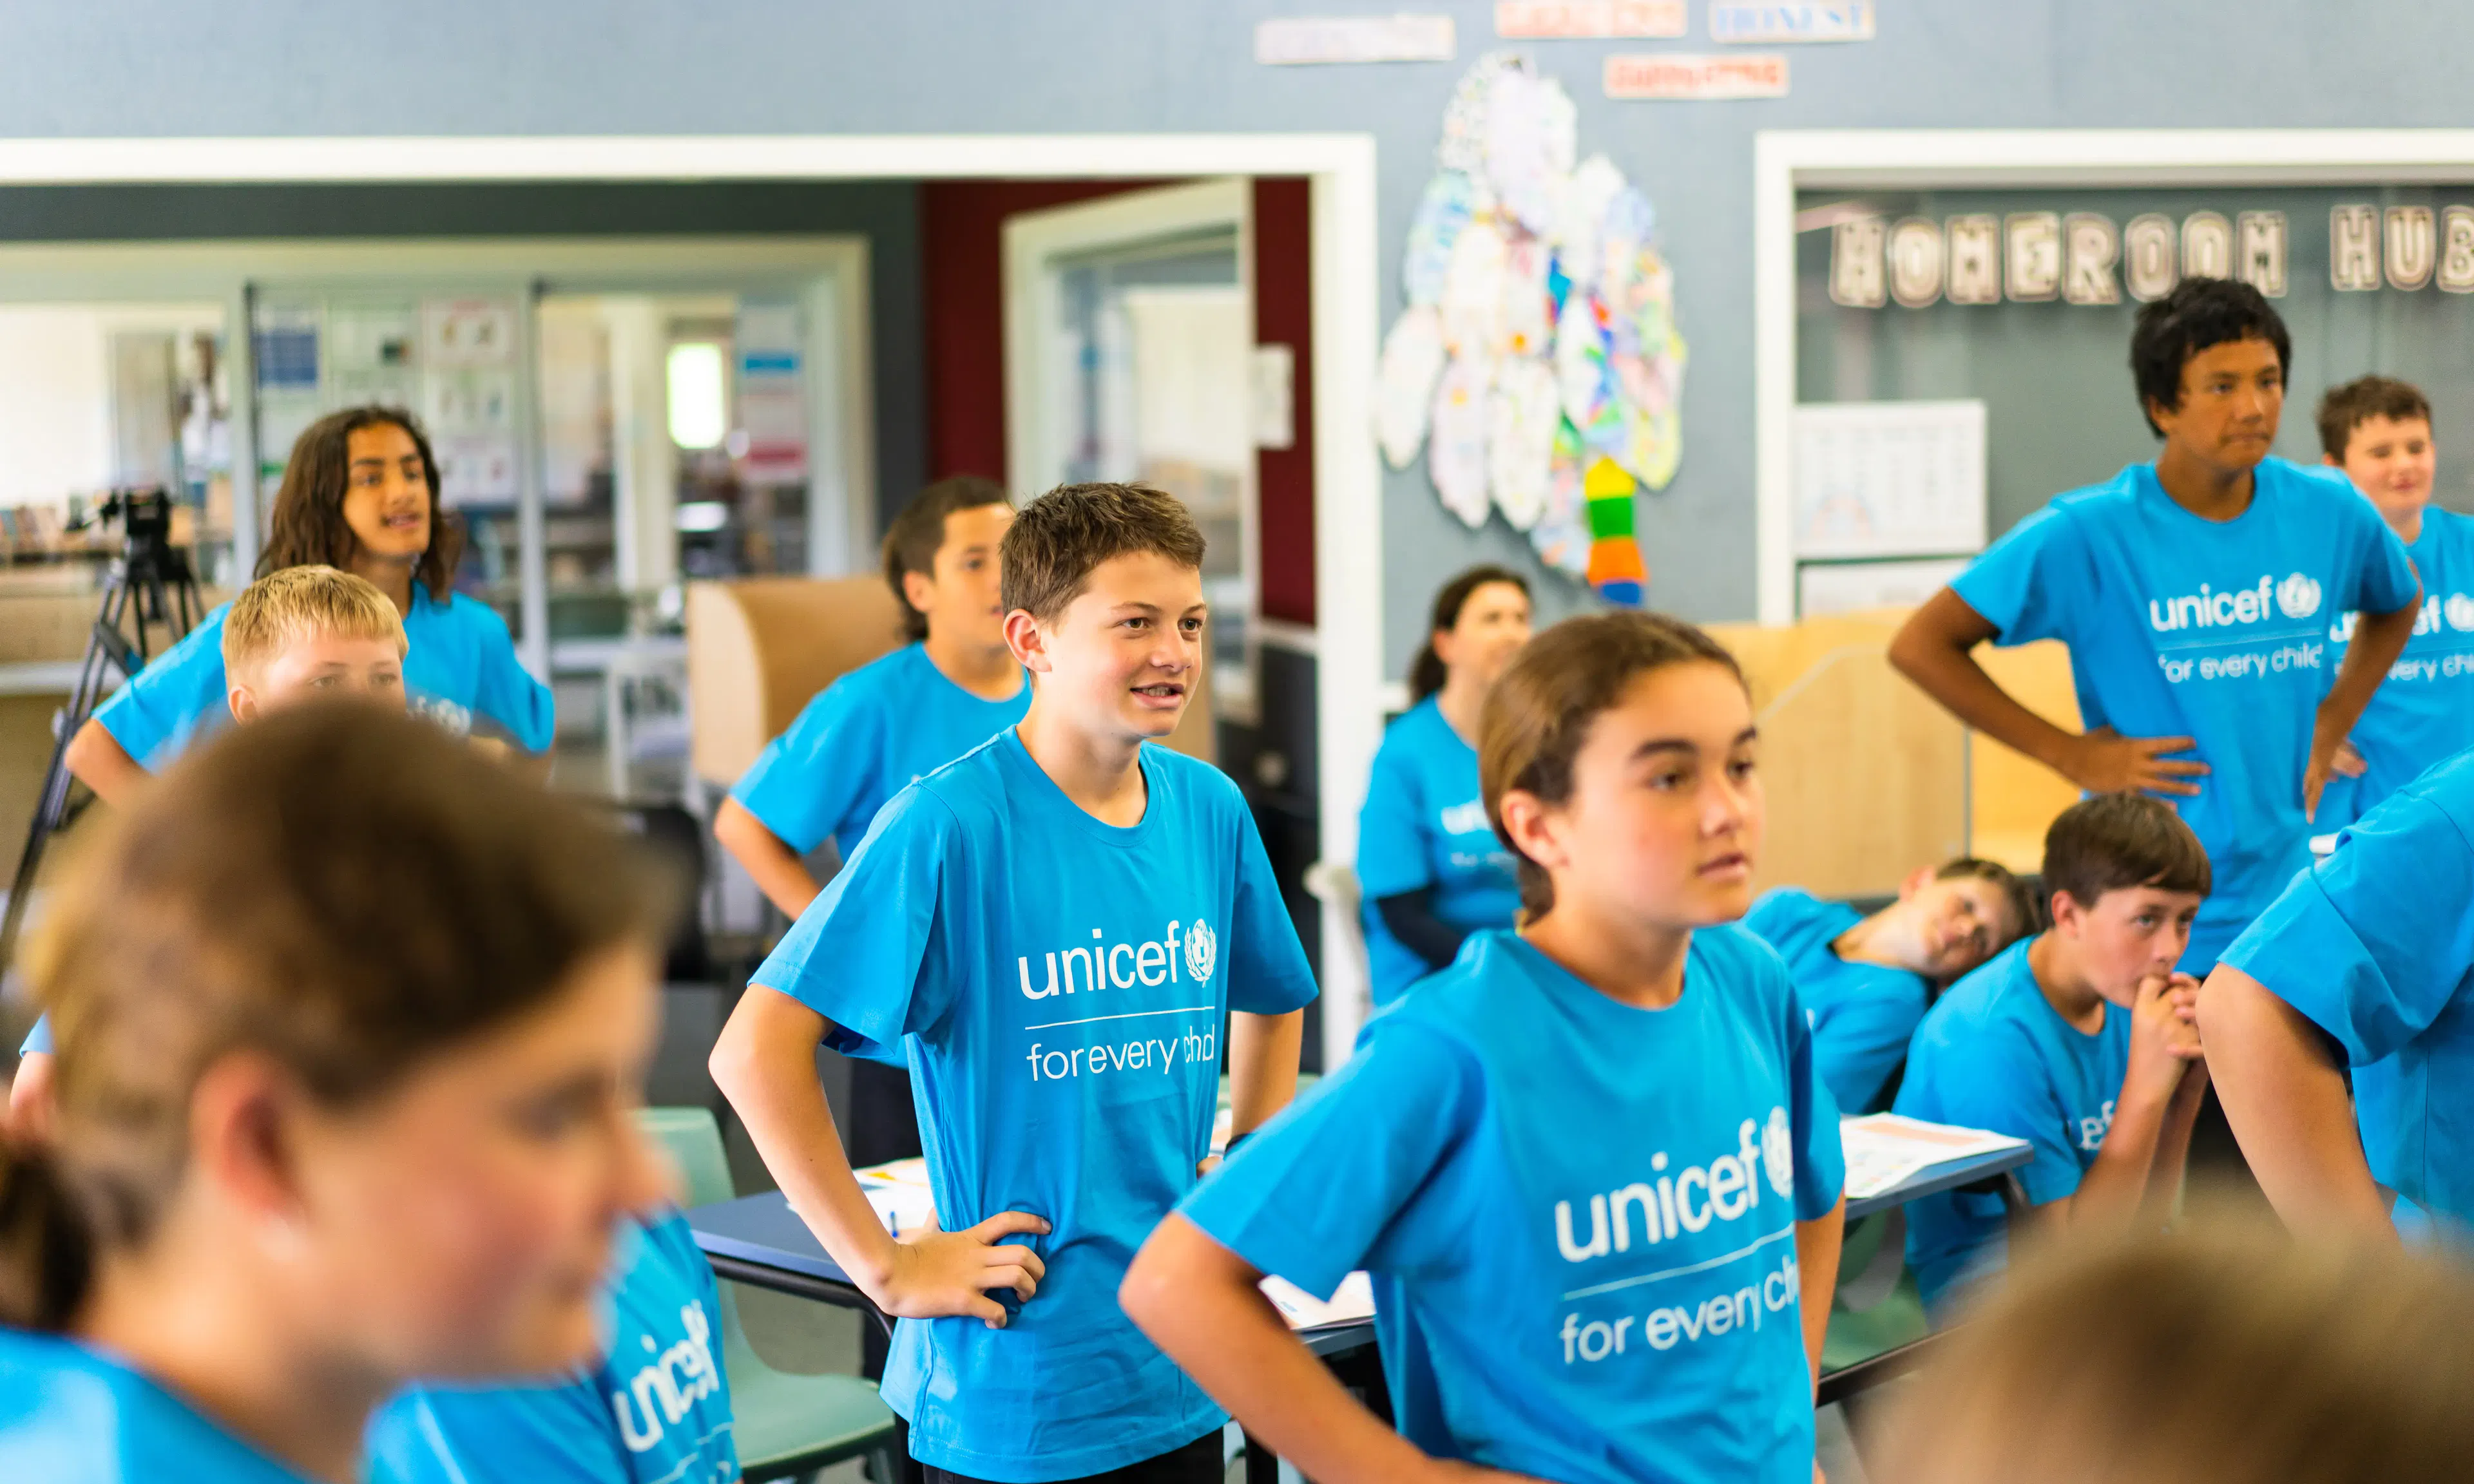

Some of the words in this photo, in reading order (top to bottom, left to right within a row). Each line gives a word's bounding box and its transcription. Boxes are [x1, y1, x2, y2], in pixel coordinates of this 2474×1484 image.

[1829, 211, 2288, 308] HOMEROOM
[2150, 575, 2273, 631] unicef
[2200, 653, 2268, 680] every
[1018, 920, 1180, 1000] unicef
[1026, 1043, 1084, 1081] for
[1088, 1038, 1178, 1075] every
[1555, 1118, 1761, 1263] unicef
[1558, 1312, 1635, 1364] for
